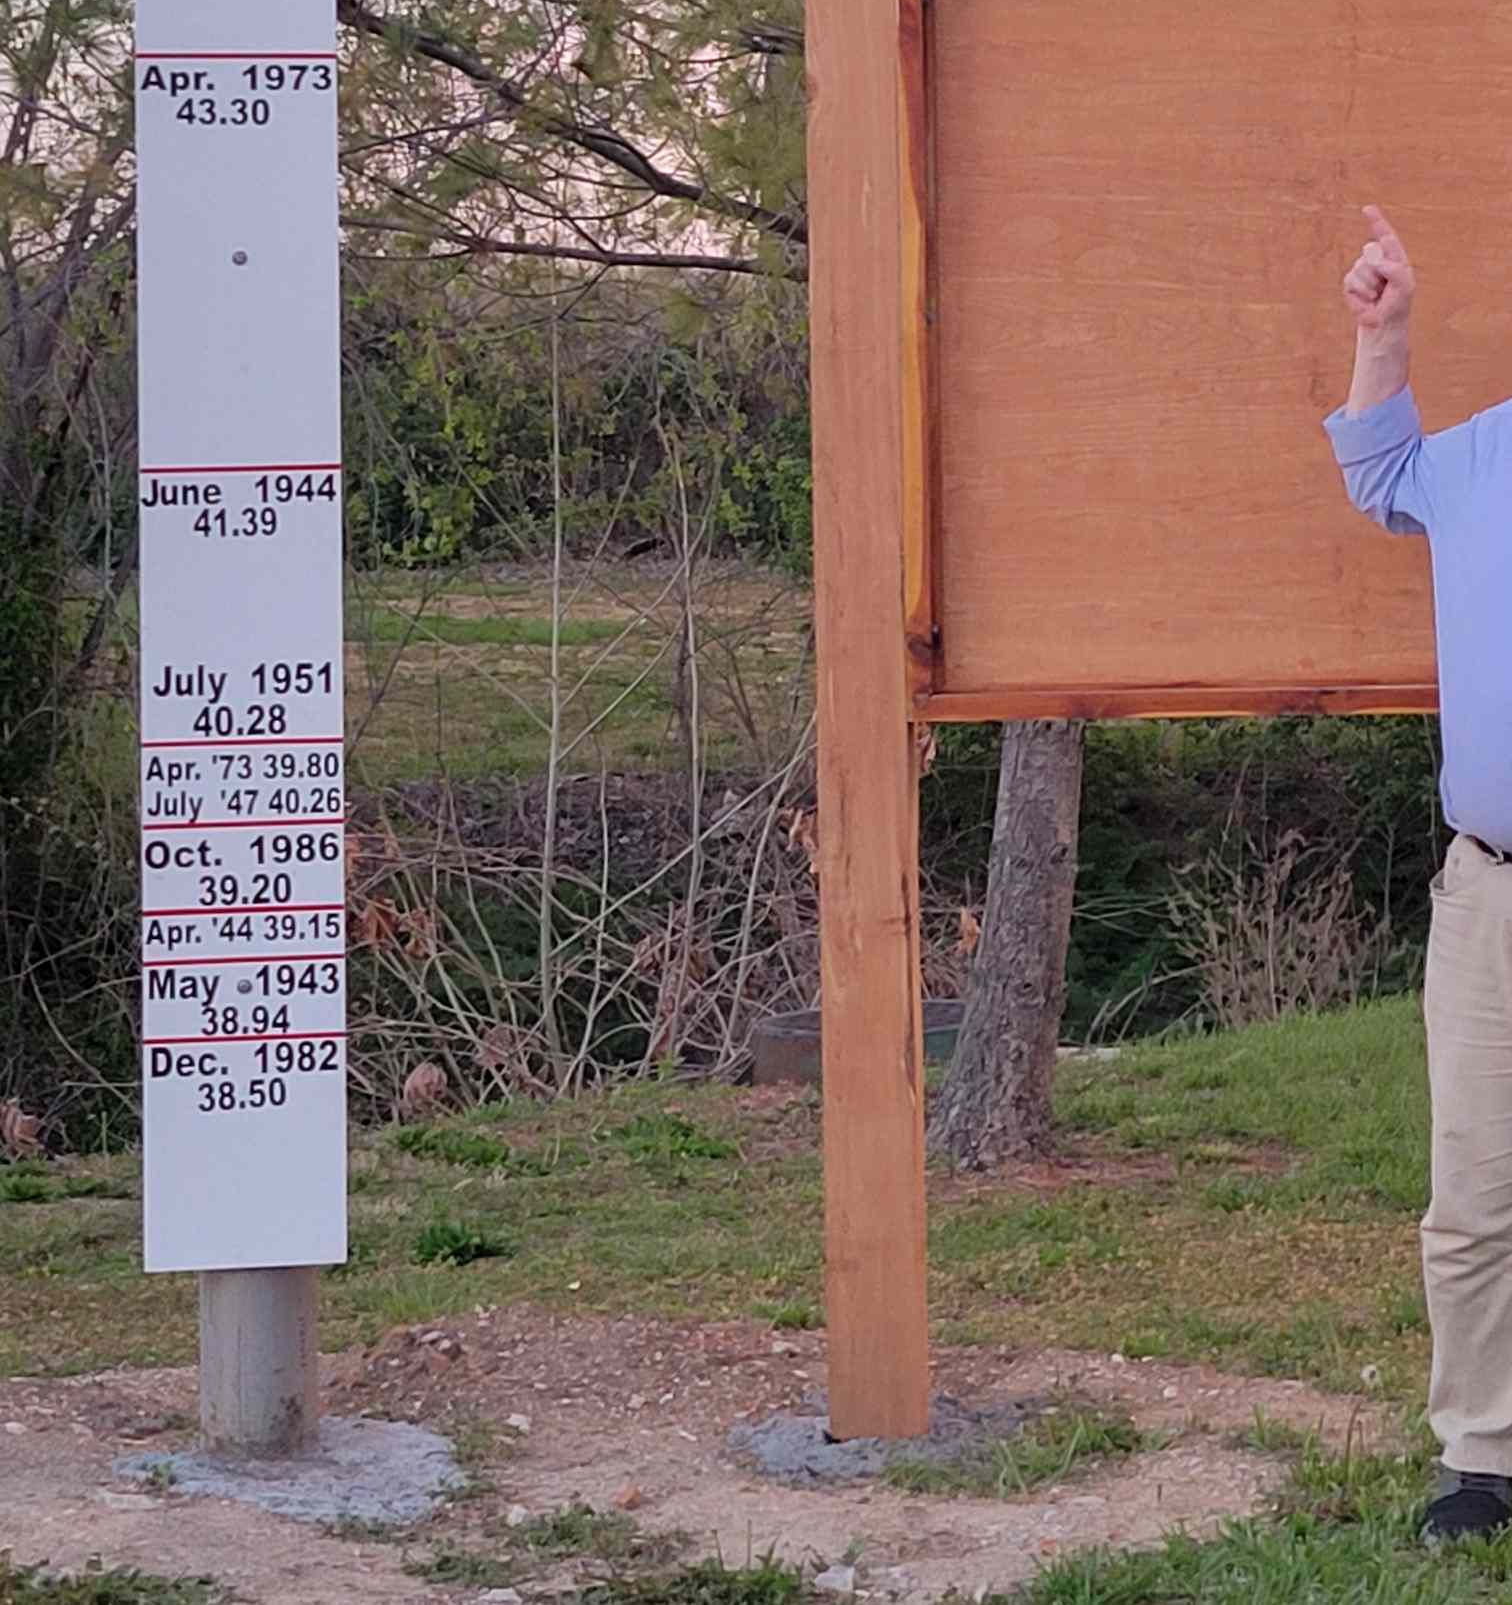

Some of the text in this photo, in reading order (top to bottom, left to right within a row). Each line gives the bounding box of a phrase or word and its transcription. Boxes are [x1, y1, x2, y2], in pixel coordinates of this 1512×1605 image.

[141, 65, 332, 96] Apr. 1973
[177, 99, 270, 125] 43.30
[142, 474, 336, 507] June 1944
[194, 508, 277, 537] 41.39
[153, 662, 332, 704] July 1951
[194, 704, 286, 736] 40.28
[146, 753, 339, 786] Apr. '73 39.80
[148, 788, 341, 822] July '47 40.26
[145, 833, 339, 869] Oct. 1986
[199, 874, 292, 905] 39.20
[146, 913, 340, 950] Apr. '44 39.15
[149, 963, 339, 1006] May 1943
[201, 1005, 290, 1036] 38.94
[151, 1040, 338, 1077] Dec. 1982
[198, 1078, 286, 1112] 38.50
